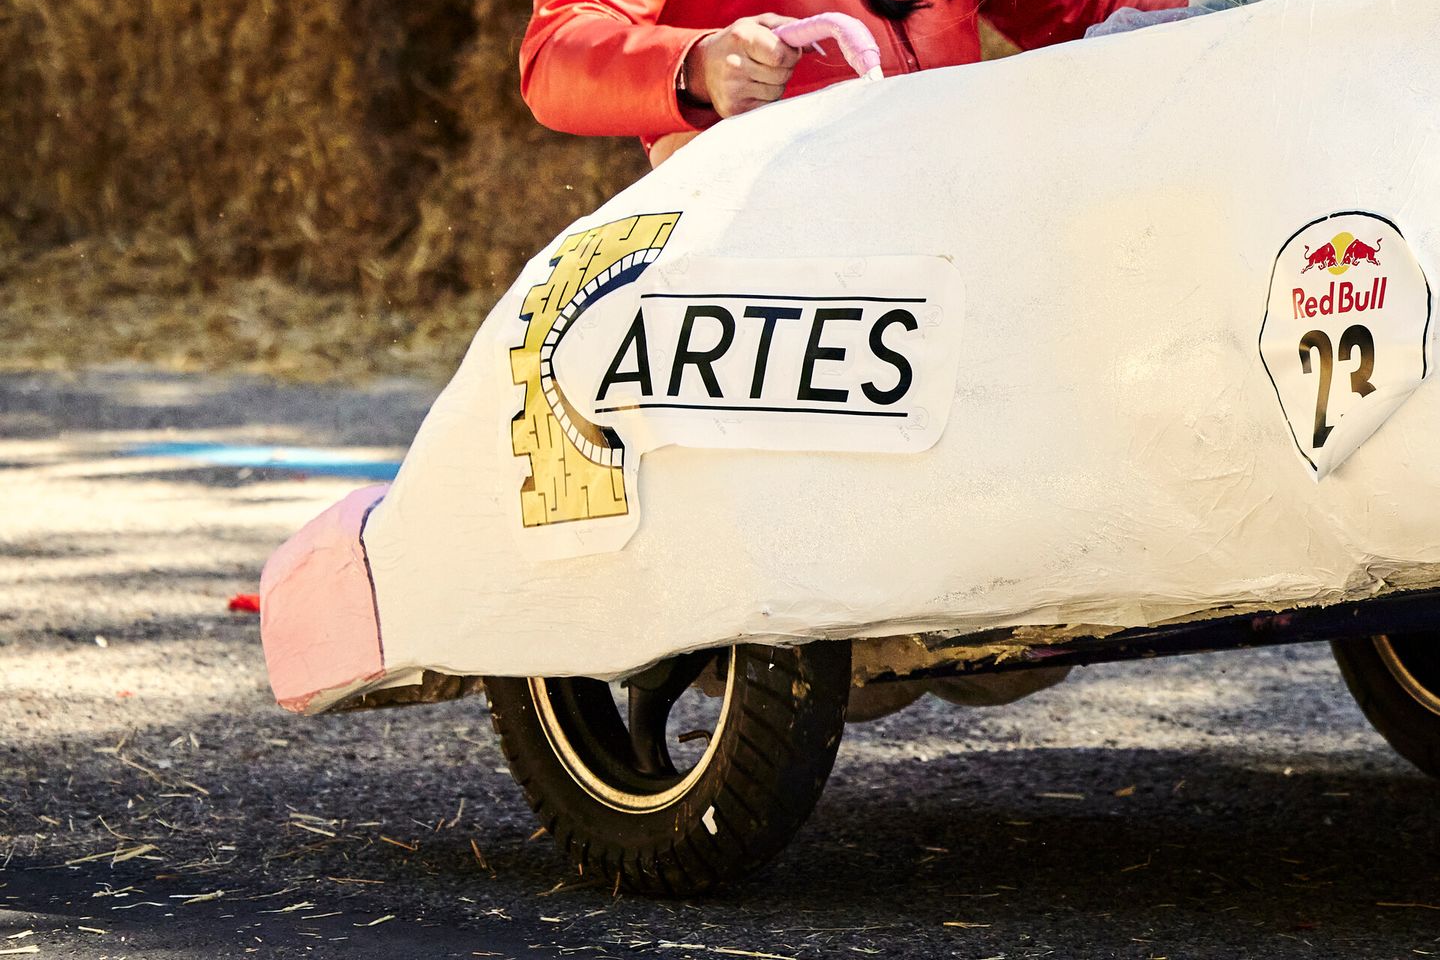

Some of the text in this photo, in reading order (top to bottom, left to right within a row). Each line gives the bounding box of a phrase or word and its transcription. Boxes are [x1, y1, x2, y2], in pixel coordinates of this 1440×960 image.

[1292, 276, 1387, 320] Red Bull
[595, 305, 919, 406] ARTES
